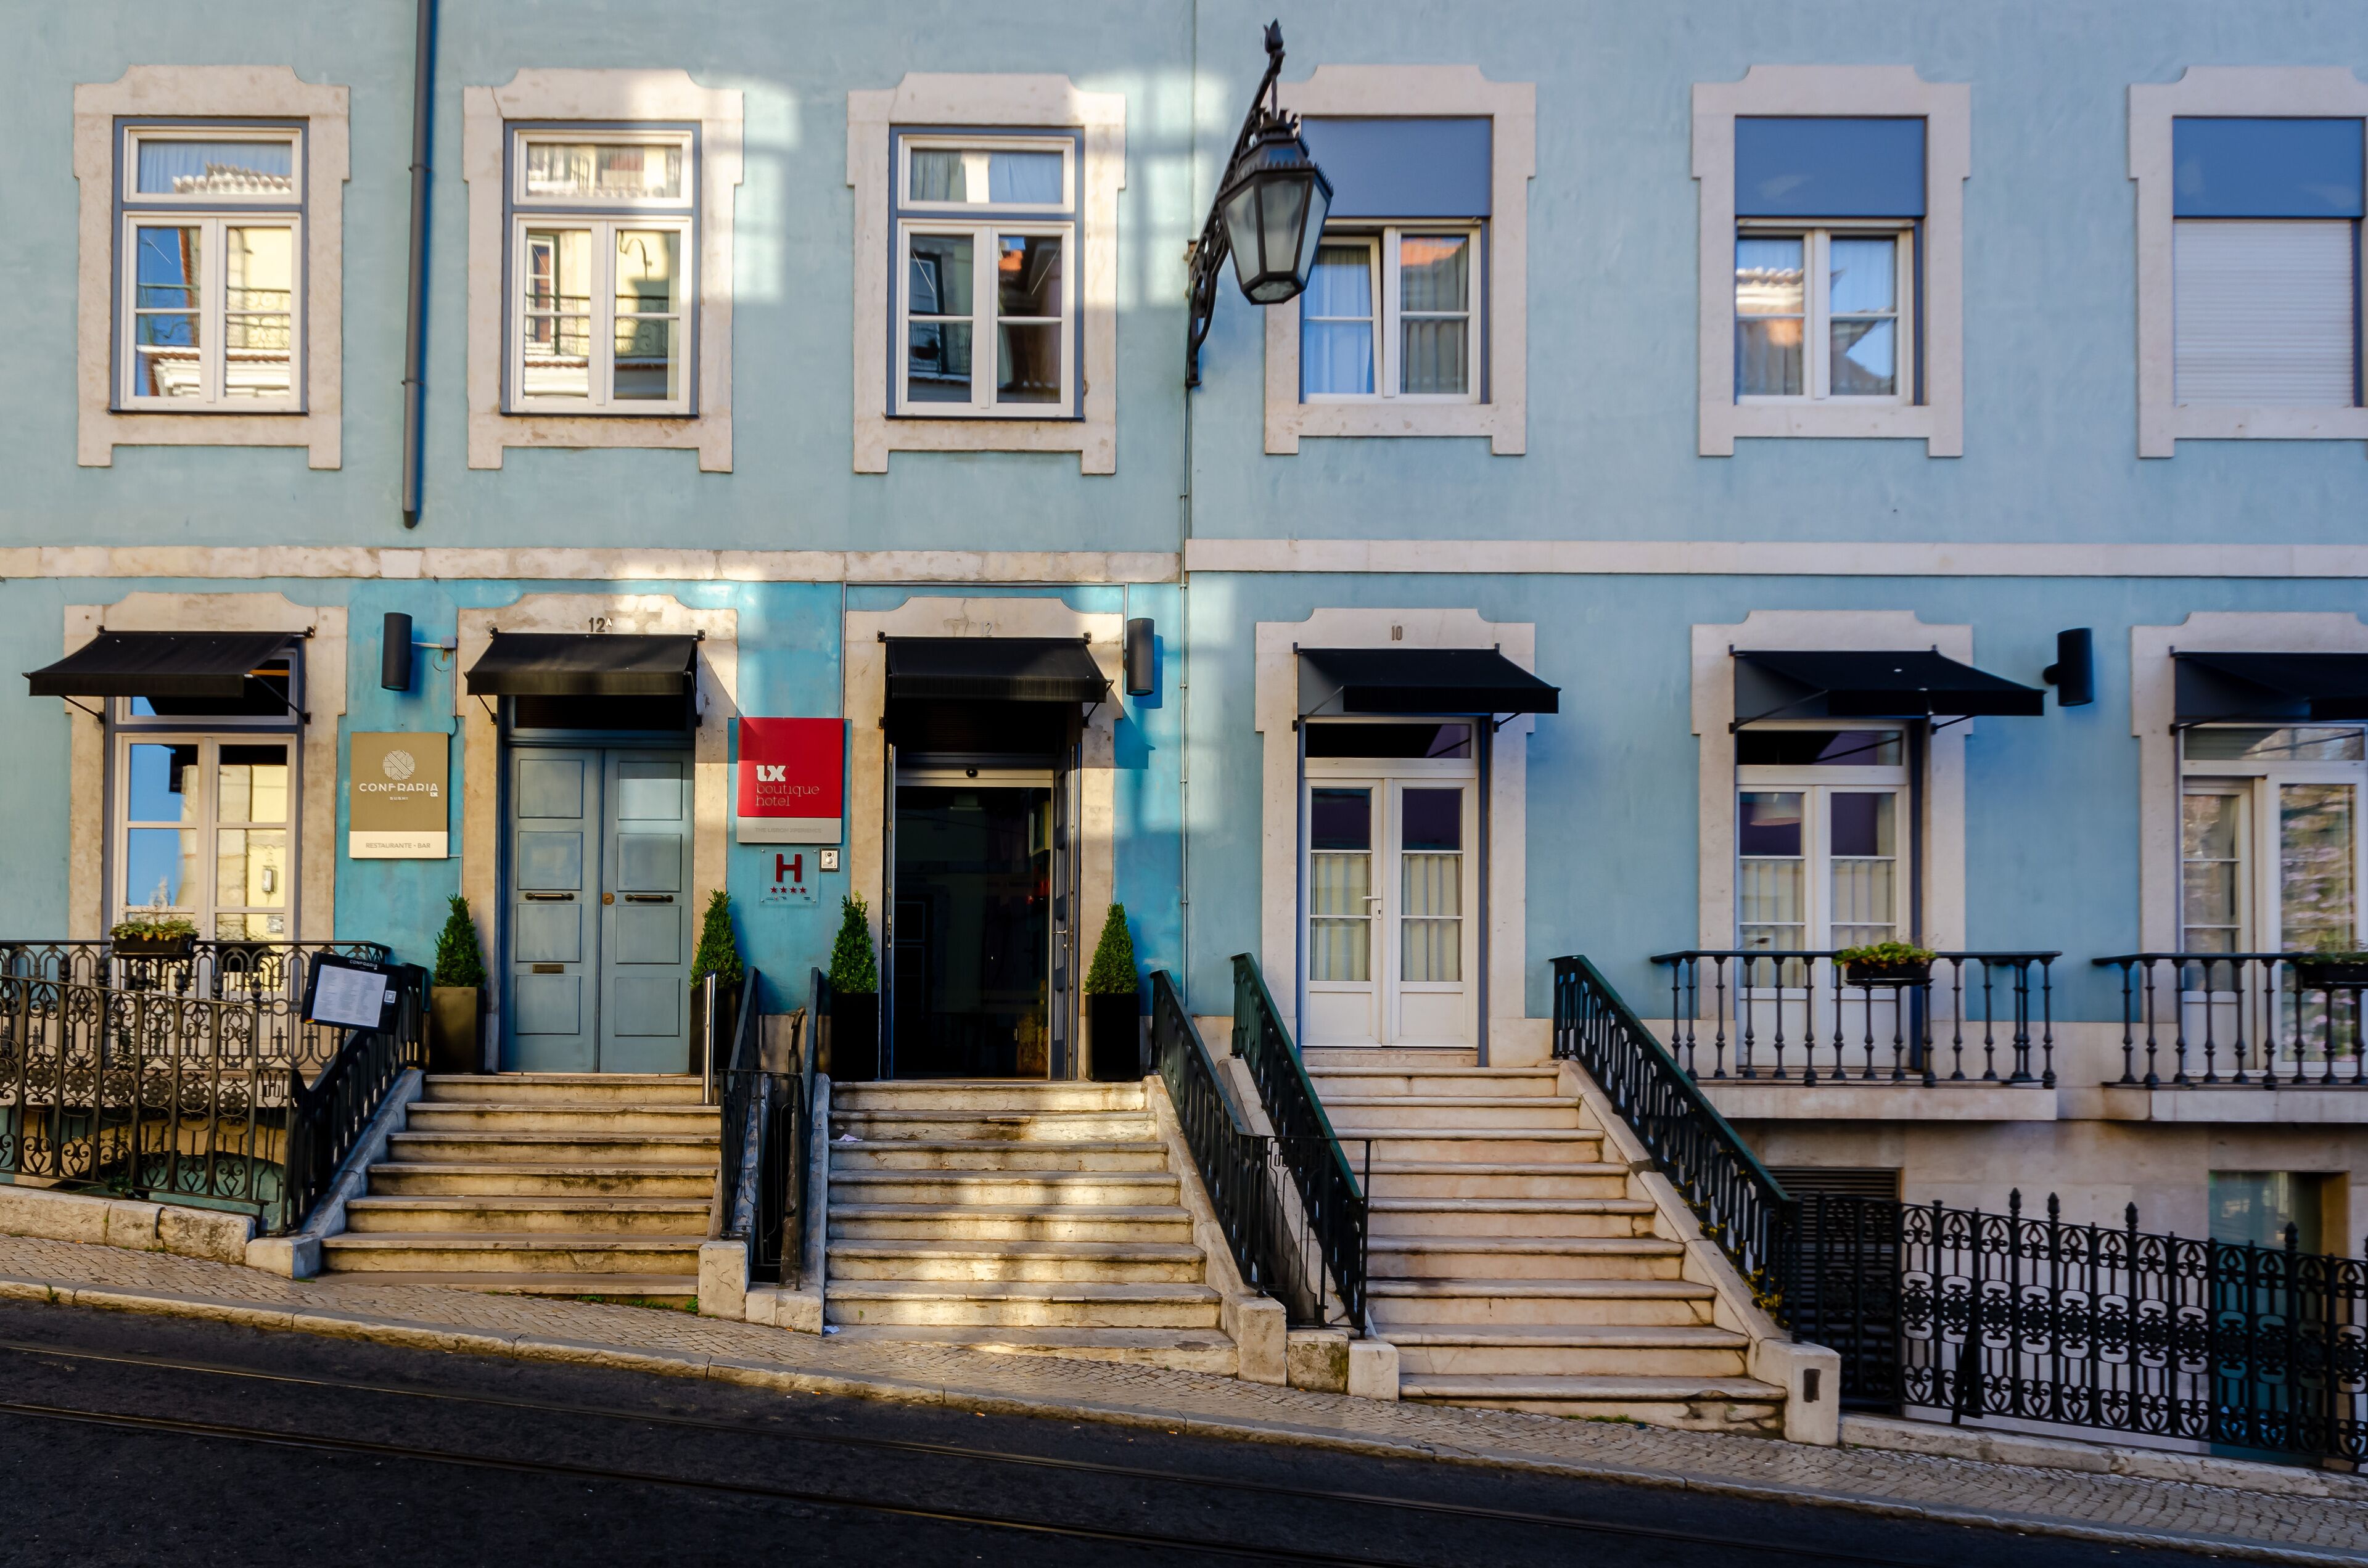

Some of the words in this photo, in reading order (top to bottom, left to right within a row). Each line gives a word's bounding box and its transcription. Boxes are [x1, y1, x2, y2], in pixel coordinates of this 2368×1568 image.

[1391, 625, 1403, 641] 10
[359, 783, 438, 792] CONFRARIA
[756, 784, 820, 797] boutique
[755, 795, 790, 807] hotel
[775, 853, 802, 883] H
